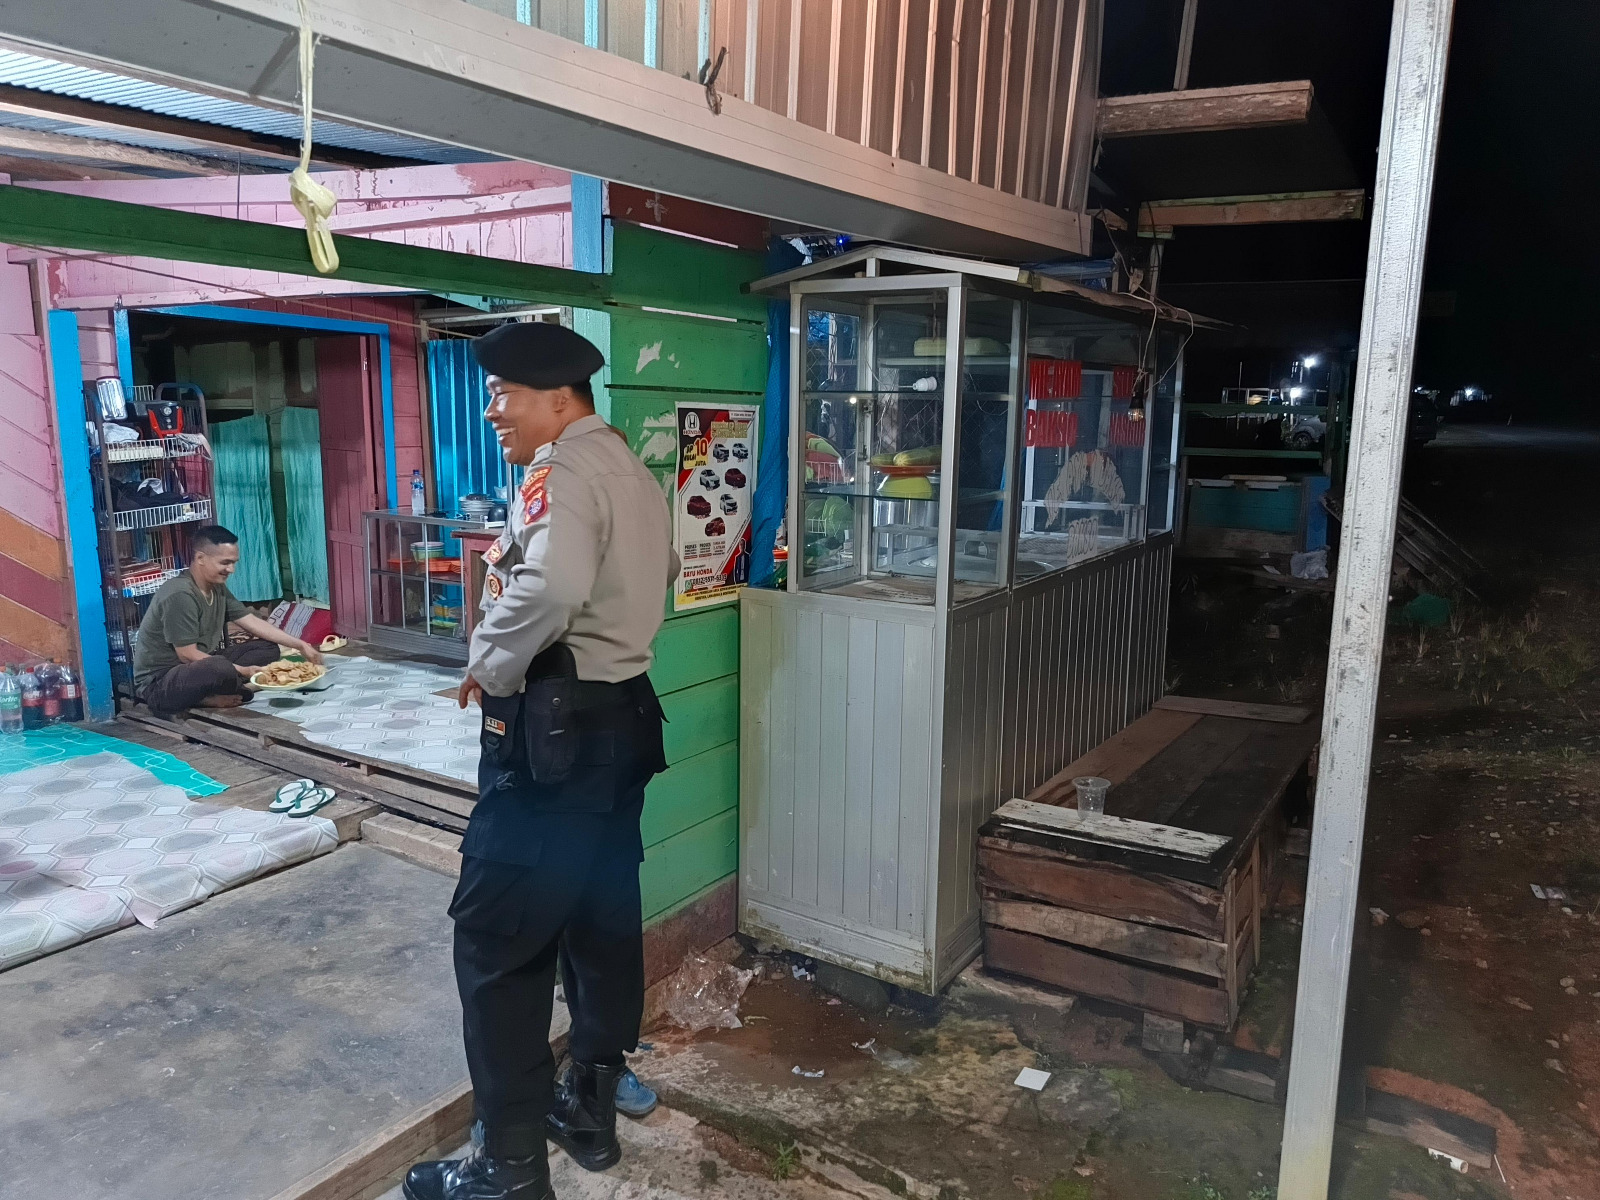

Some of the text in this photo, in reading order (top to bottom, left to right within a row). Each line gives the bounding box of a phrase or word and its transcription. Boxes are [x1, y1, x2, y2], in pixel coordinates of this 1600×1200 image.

[1026, 409, 1078, 448] BAKSO
[695, 439, 707, 456] 10
[697, 568, 712, 576] HONDA
